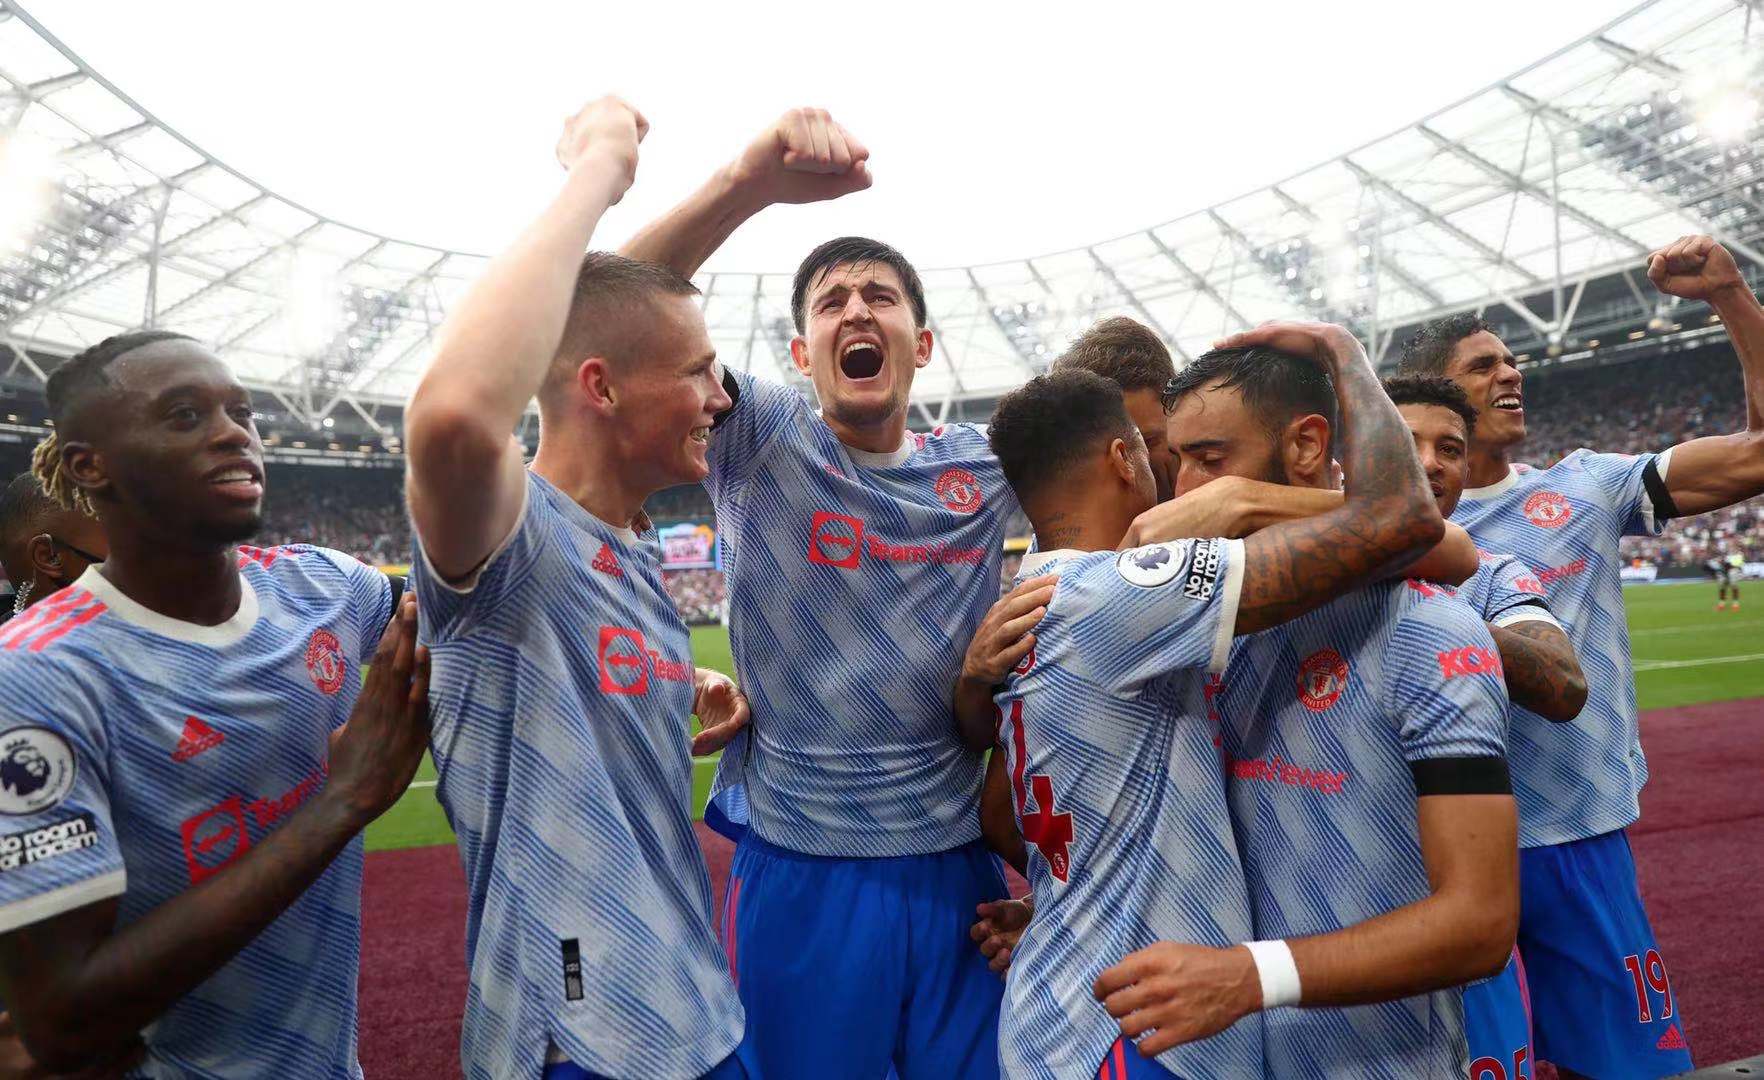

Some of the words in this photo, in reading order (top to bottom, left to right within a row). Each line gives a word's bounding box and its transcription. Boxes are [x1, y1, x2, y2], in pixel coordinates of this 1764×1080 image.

[1184, 575, 1202, 600] No
[1302, 694, 1331, 708] UNITED
[24, 818, 87, 848] room
[0, 850, 23, 871] or
[26, 831, 98, 864] racism
[1624, 949, 1673, 1024] 19
